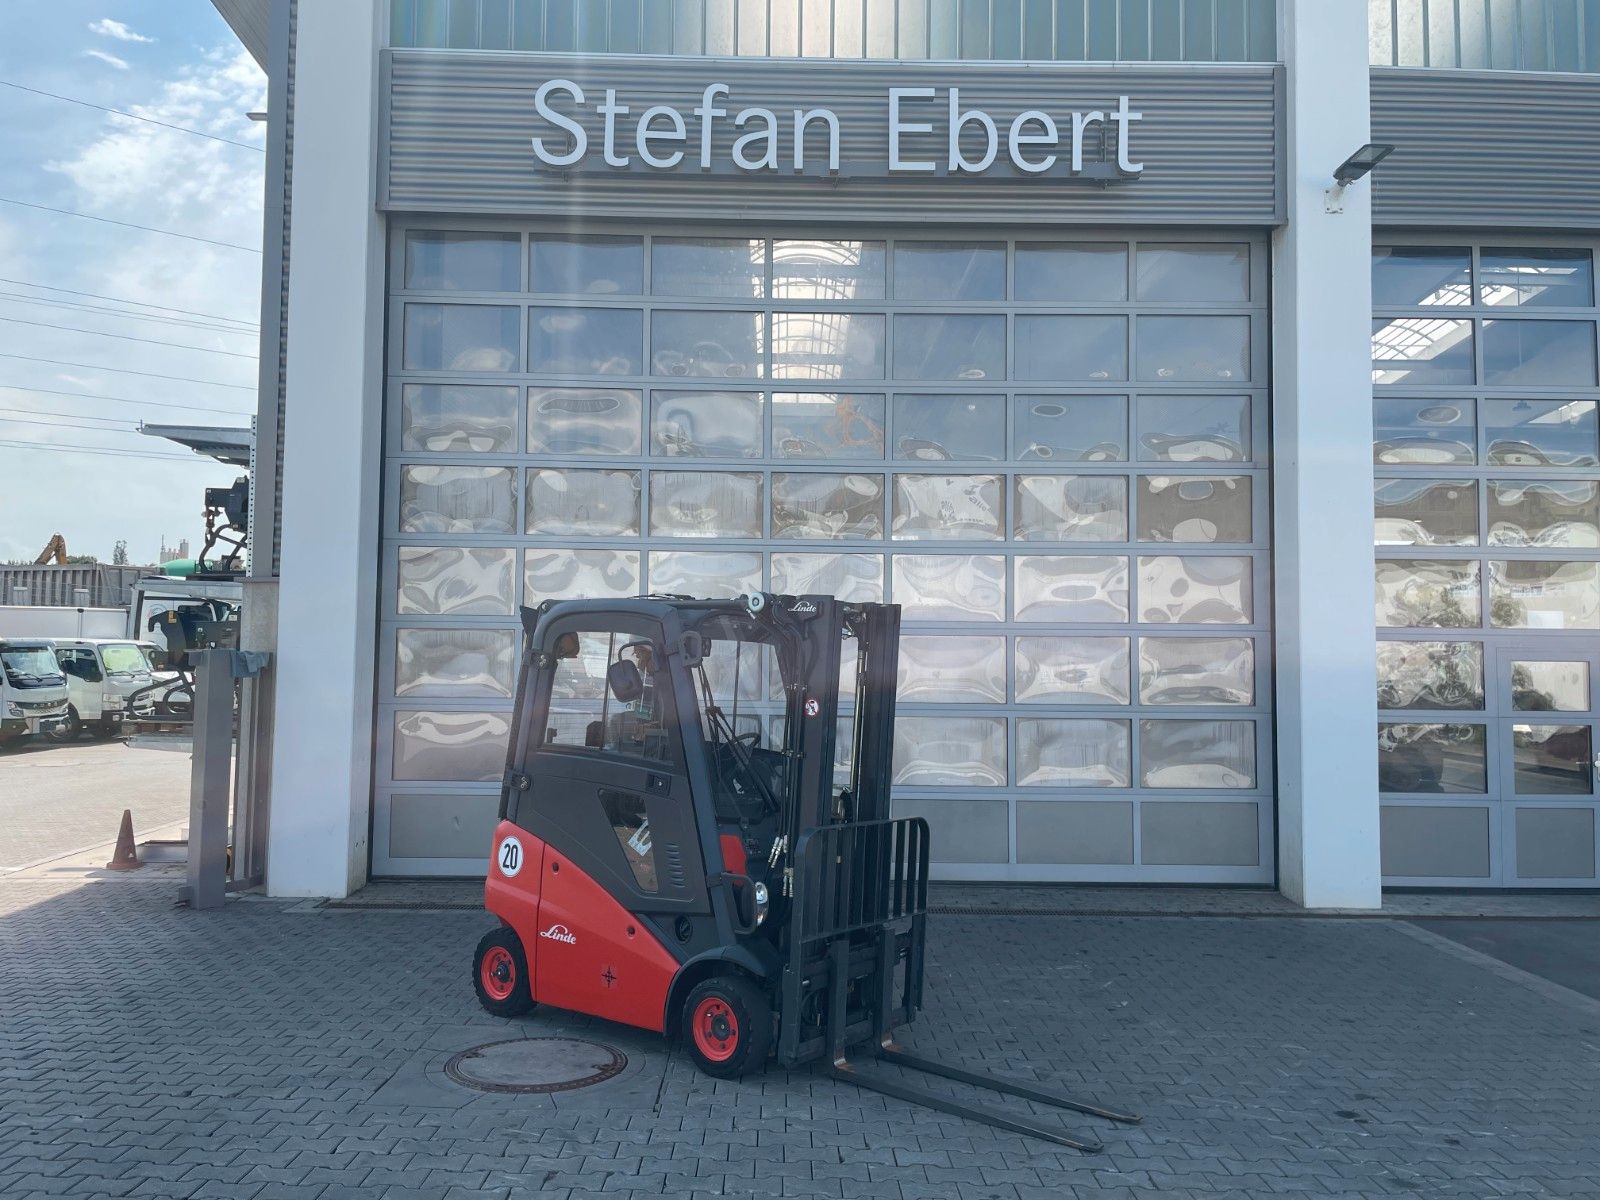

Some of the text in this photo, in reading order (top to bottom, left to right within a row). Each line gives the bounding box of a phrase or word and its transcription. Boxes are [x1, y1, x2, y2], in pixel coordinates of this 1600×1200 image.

[531, 79, 1144, 173] Stefan Ebert
[787, 600, 817, 613] Linde
[502, 843, 518, 870] 20
[540, 924, 577, 945] Linde
